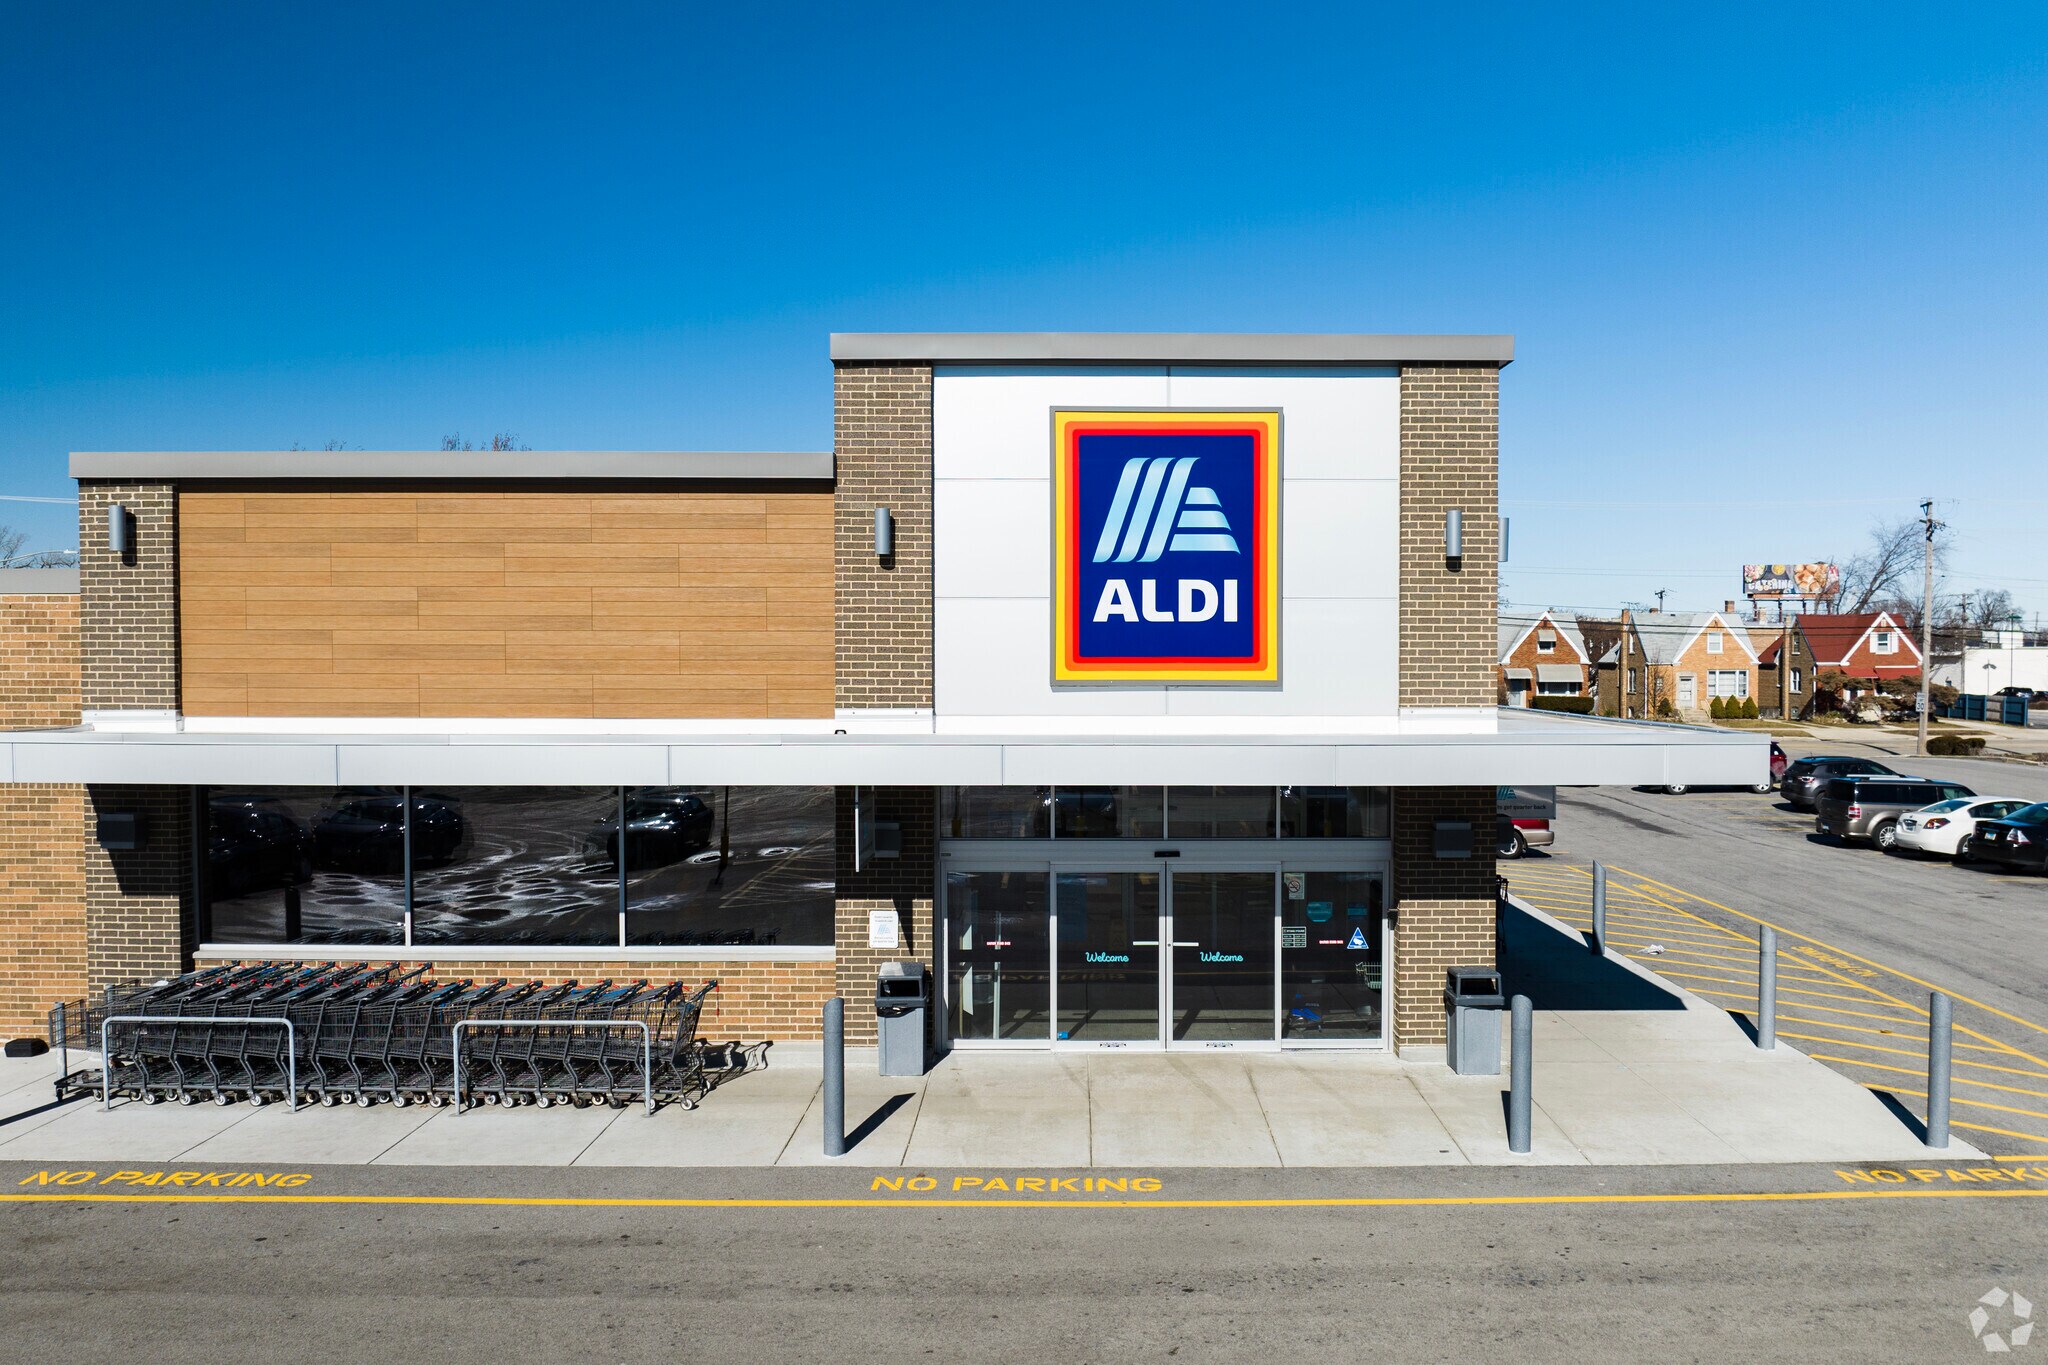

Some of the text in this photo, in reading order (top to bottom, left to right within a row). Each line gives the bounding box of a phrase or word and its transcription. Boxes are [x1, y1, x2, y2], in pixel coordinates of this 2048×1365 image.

[1748, 578, 1794, 591] CATERING
[1093, 579, 1238, 622] ALDI
[1917, 702, 1925, 710] 30
[1513, 803, 1533, 811] quarter
[1085, 951, 1130, 963] Welcome
[1199, 951, 1244, 963] Welcome
[18, 1170, 313, 1188] NO PARKING
[1833, 1167, 2048, 1184] NO PARKI
[870, 1175, 1163, 1193] NO PARKING
